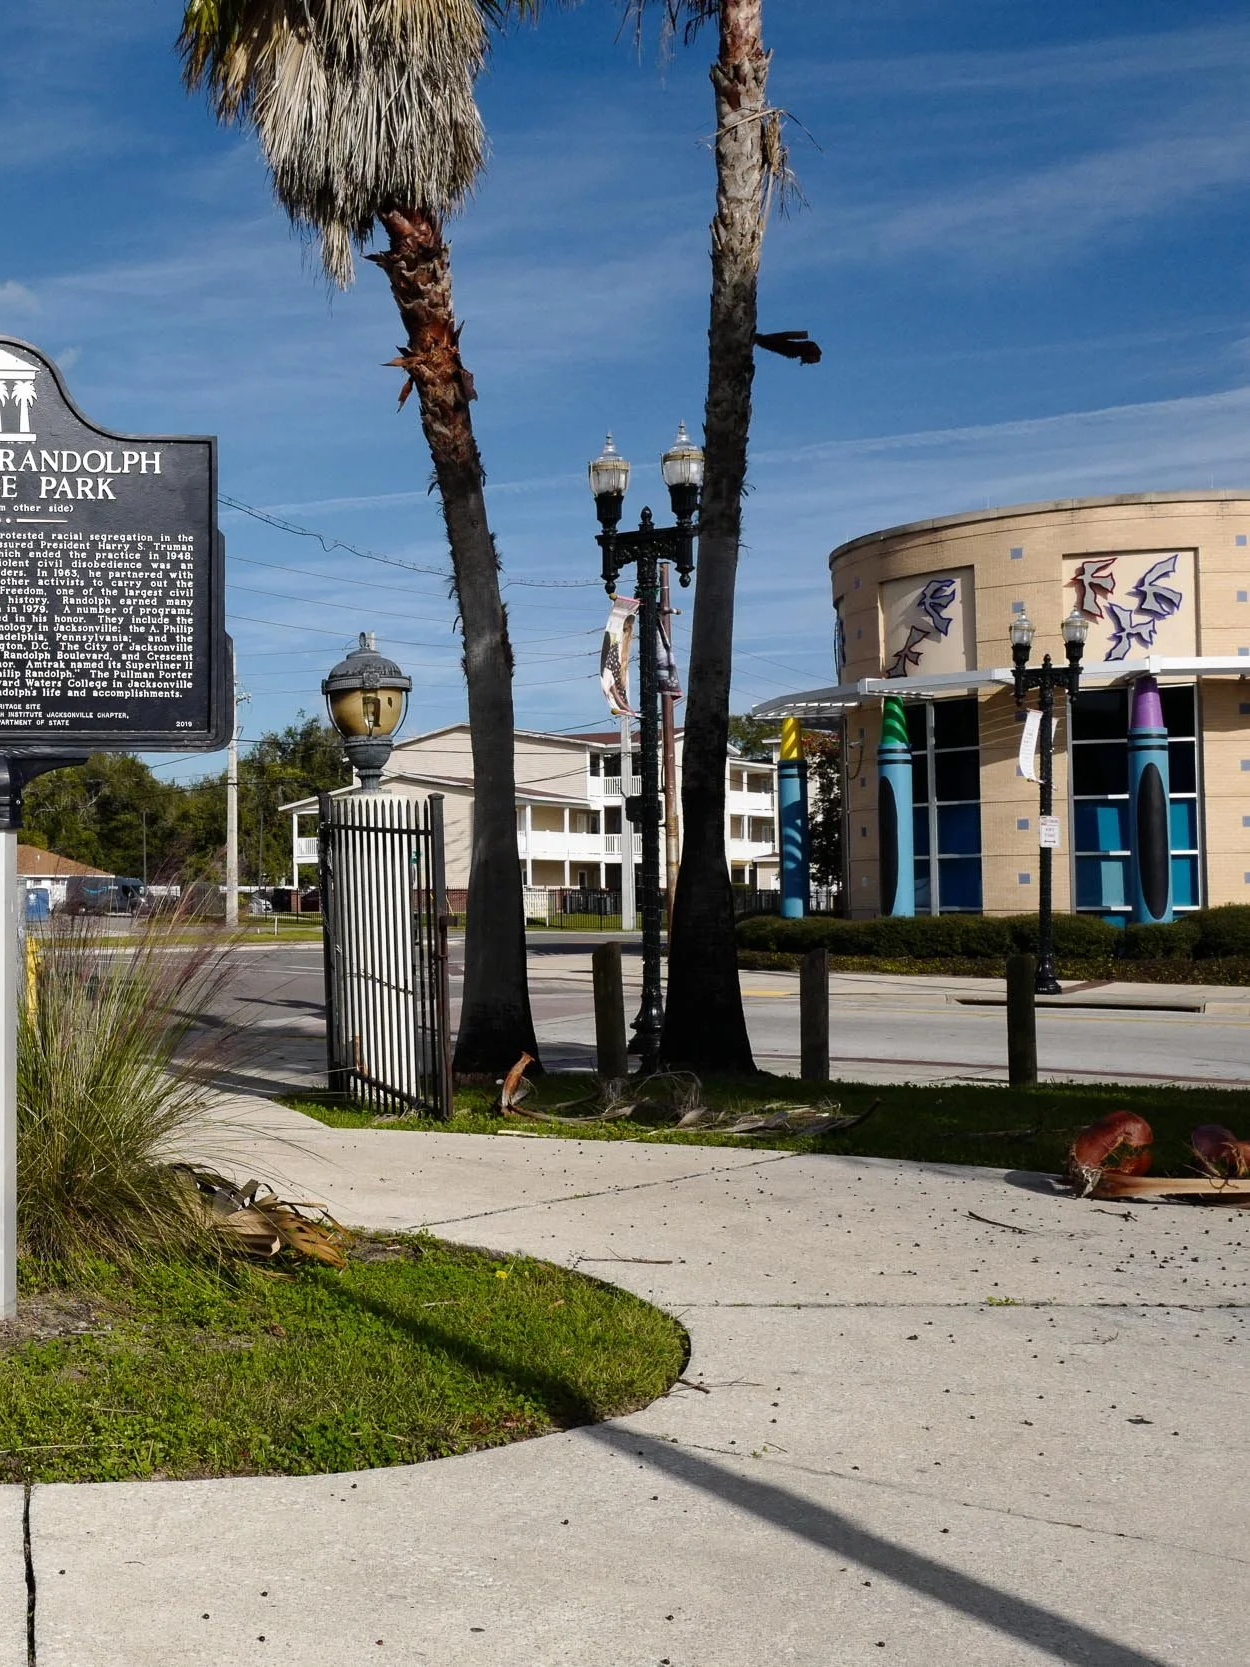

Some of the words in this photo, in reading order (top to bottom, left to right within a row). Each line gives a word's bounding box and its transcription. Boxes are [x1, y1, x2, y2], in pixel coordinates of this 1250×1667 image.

[39, 476, 116, 500] PARK
[14, 503, 41, 512] other
[49, 503, 74, 513] side)
[90, 533, 152, 543] segregation
[40, 541, 90, 549] President
[98, 542, 129, 552] Harry
[95, 551, 140, 561] practice
[71, 560, 142, 568] disobedience
[108, 570, 162, 580] partnered
[111, 580, 141, 588] carry
[125, 588, 162, 598] largest
[8, 596, 49, 606] history.
[62, 597, 110, 607] Randolph
[166, 599, 193, 608] many
[22, 604, 48, 612] 1979.
[76, 605, 116, 613] number
[54, 614, 86, 622] honor.
[97, 614, 124, 625] They
[131, 615, 169, 623] include
[163, 624, 193, 634] Philip
[84, 642, 107, 652] City
[129, 642, 192, 651] Jacksonville
[3, 650, 50, 661] Randolph
[146, 652, 192, 660] Crescent
[26, 660, 65, 668] Amtrak
[70, 660, 103, 668] named
[125, 660, 181, 671] Superliner
[25, 669, 79, 679] Randolph."
[114, 670, 154, 678] Pullman
[159, 670, 192, 678] Porter
[26, 678, 61, 686] Waters
[67, 679, 107, 689] College
[127, 679, 192, 687] Jacksonville
[92, 688, 182, 698] accomplishments.
